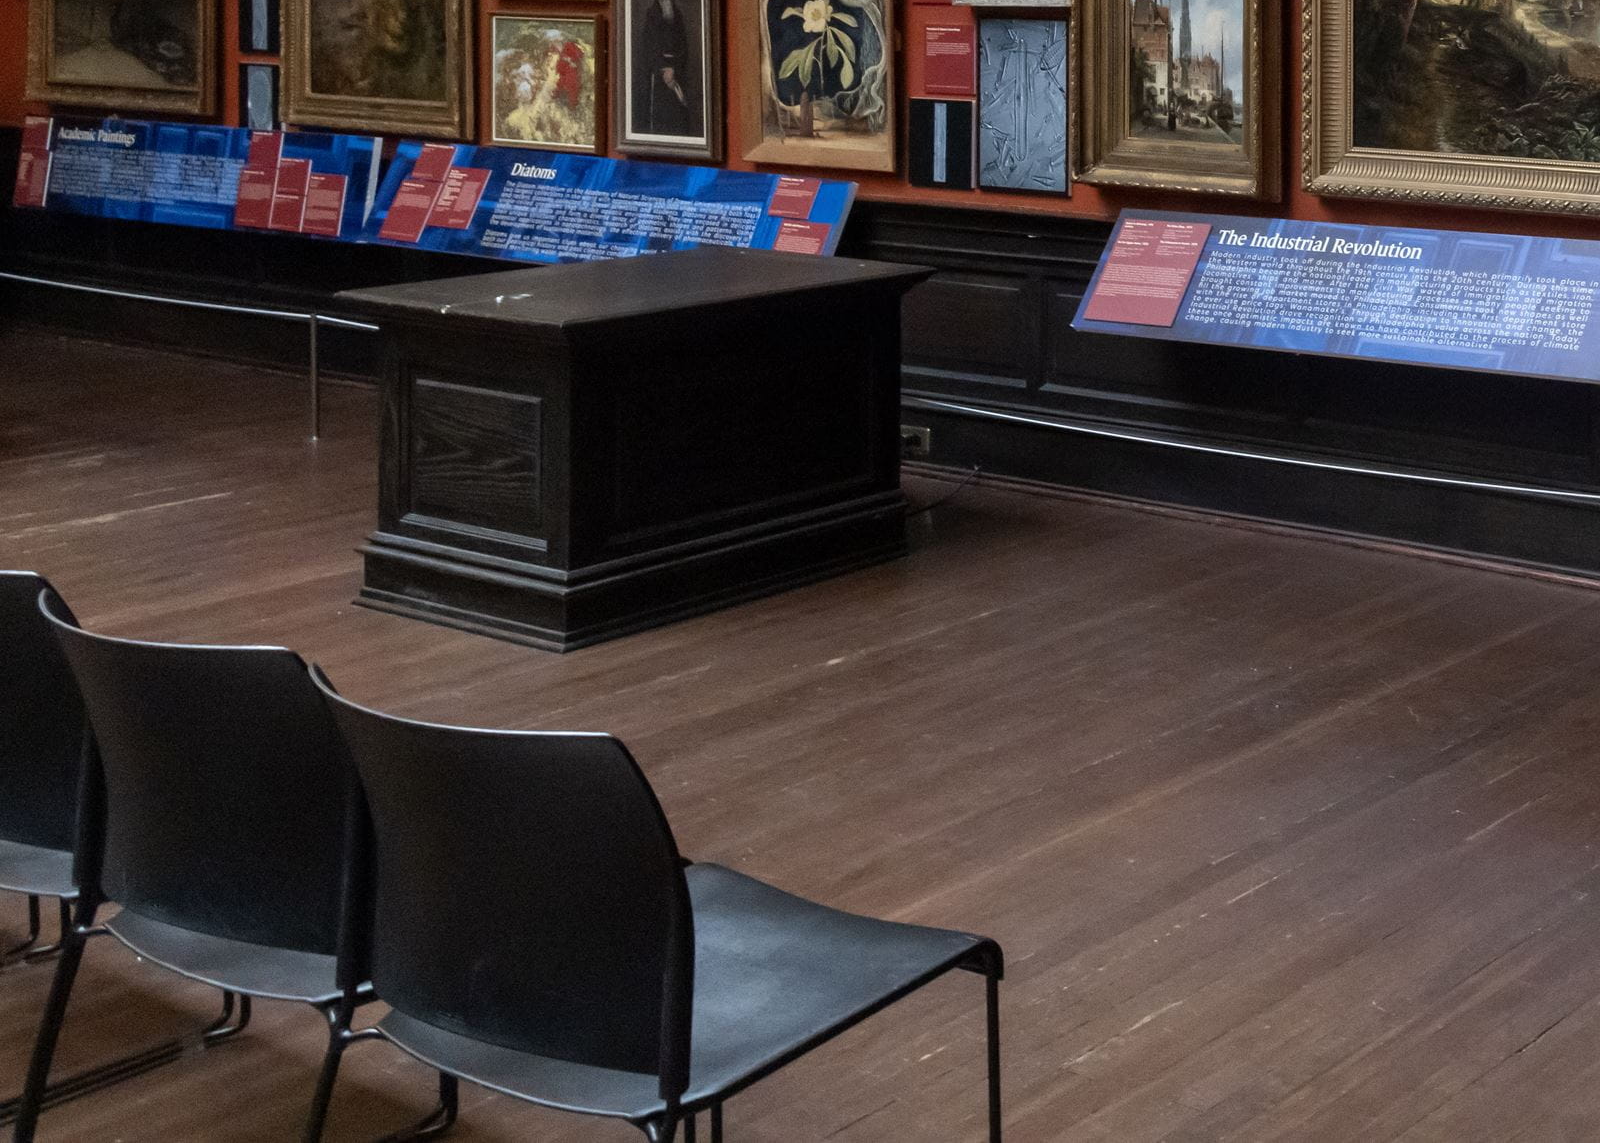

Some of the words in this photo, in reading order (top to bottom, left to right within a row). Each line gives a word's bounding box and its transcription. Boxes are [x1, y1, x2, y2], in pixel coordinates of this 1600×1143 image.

[58, 127, 95, 142] Academic
[98, 129, 136, 147] Paintings
[511, 162, 557, 180] Diatoms
[1218, 229, 1247, 245] The
[1250, 232, 1330, 252] Industrial
[1331, 238, 1422, 260] Revolution
